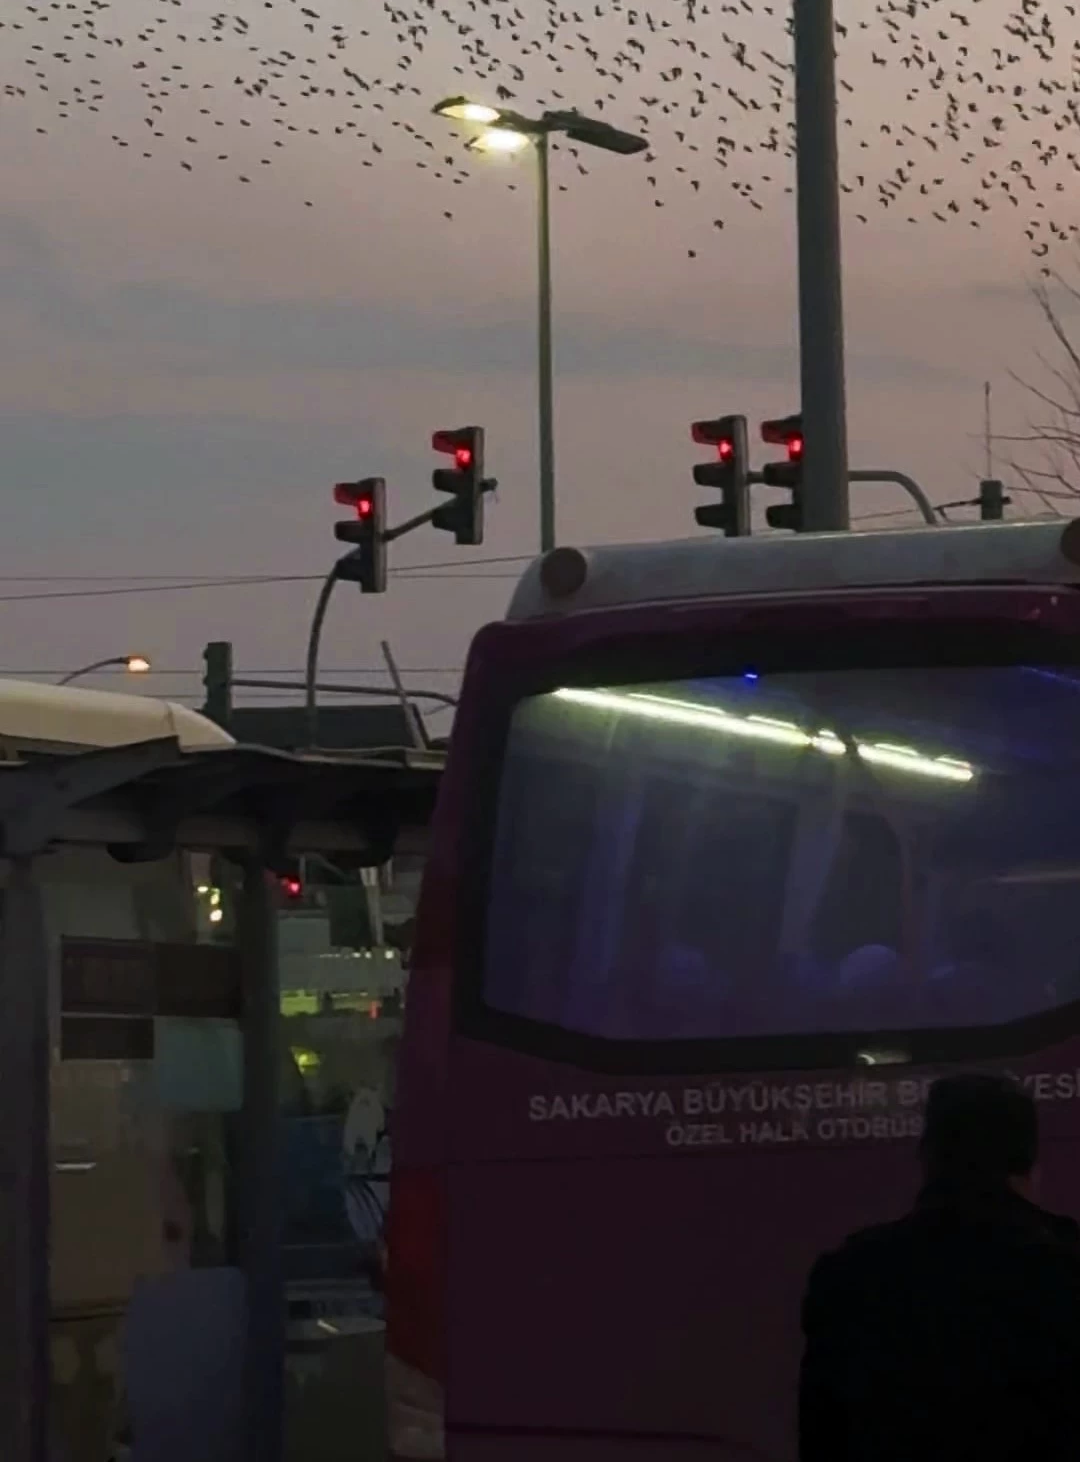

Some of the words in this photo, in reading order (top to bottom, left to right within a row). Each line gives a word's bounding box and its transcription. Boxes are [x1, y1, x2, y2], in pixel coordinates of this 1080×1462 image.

[528, 1091, 675, 1121] SAKARYA
[683, 1078, 890, 1118] BÜYÜKŞEHİR
[665, 1119, 734, 1146] ÖZEL
[739, 1121, 809, 1144] HALK
[817, 1112, 925, 1141] OTOBÜS
